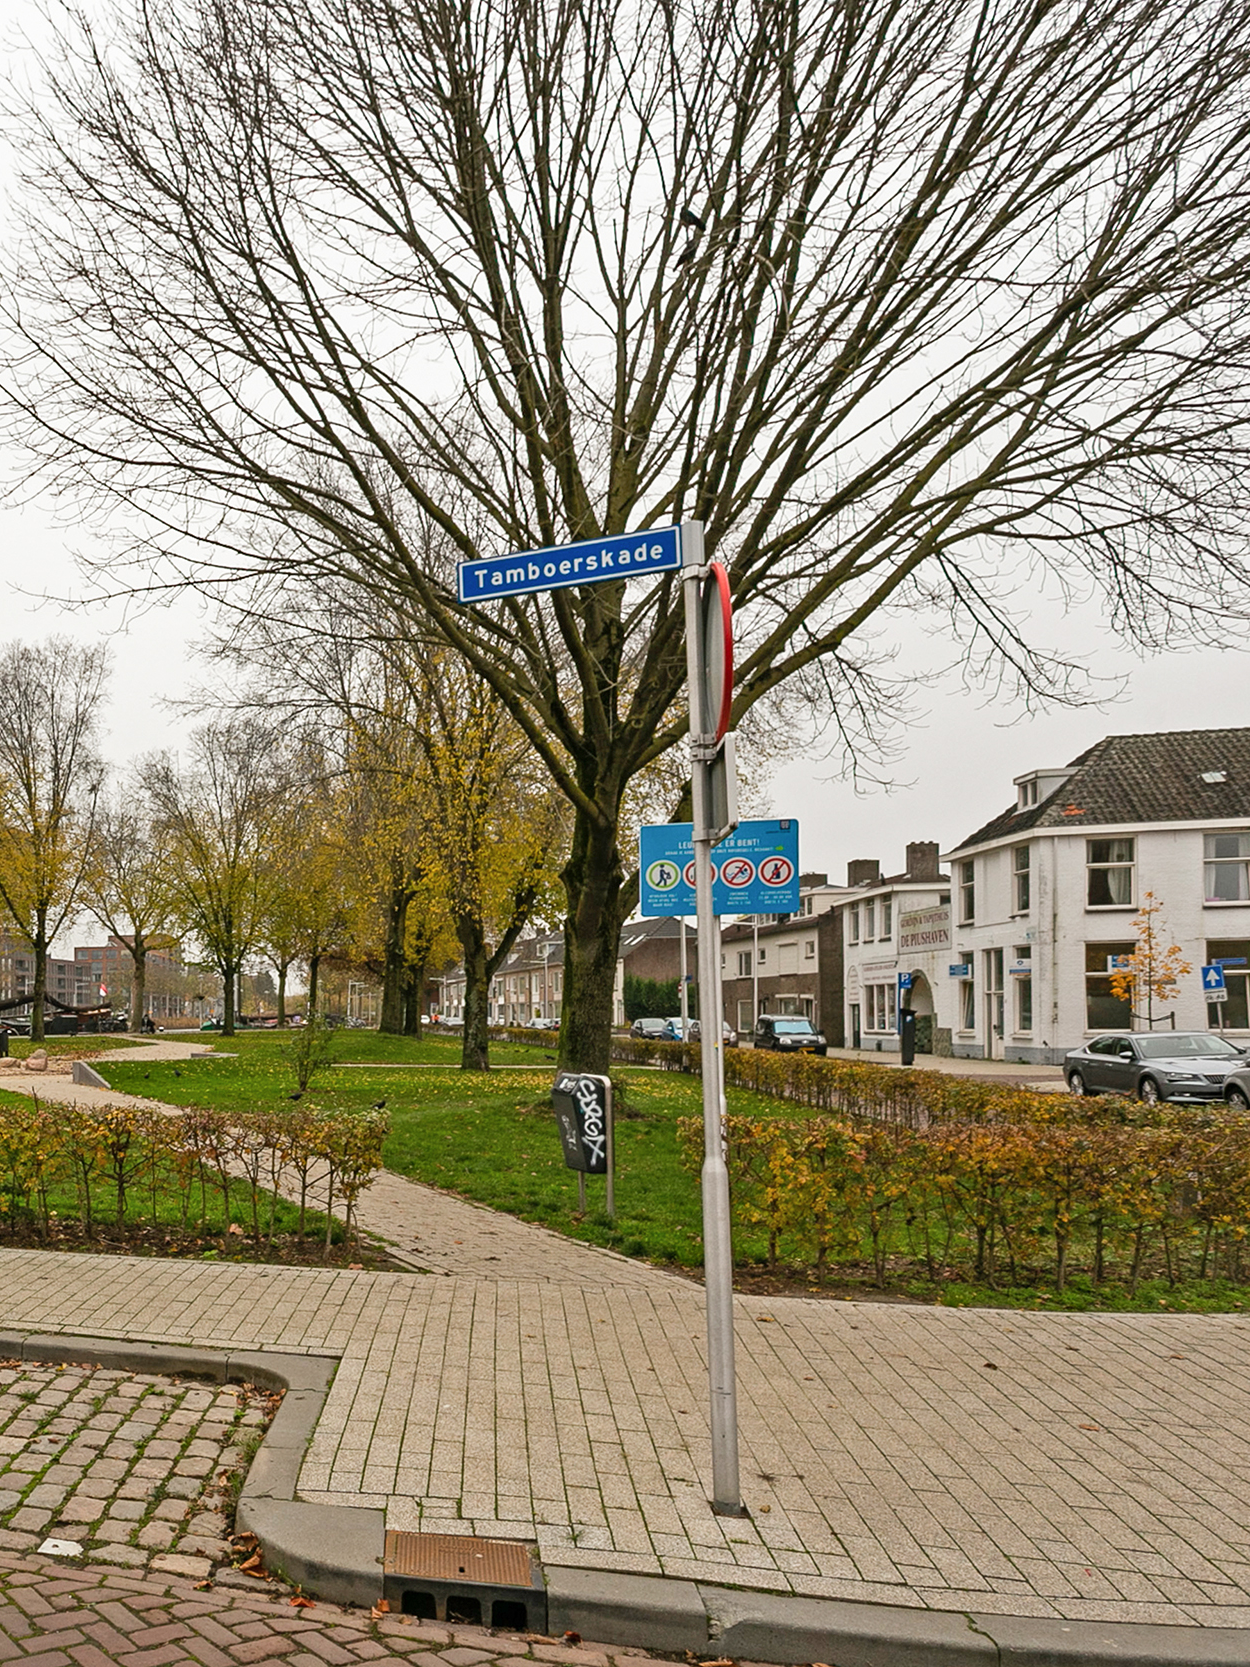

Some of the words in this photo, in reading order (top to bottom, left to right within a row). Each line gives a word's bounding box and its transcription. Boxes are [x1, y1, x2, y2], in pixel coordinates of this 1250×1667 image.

[475, 543, 664, 588] Tamboerskade
[678, 841, 695, 849] LEU
[725, 839, 736, 847] ER
[737, 838, 760, 847] BENT!
[901, 934, 910, 948] DE
[910, 928, 949, 946] PIUSHAVEN
[901, 973, 909, 983] P
